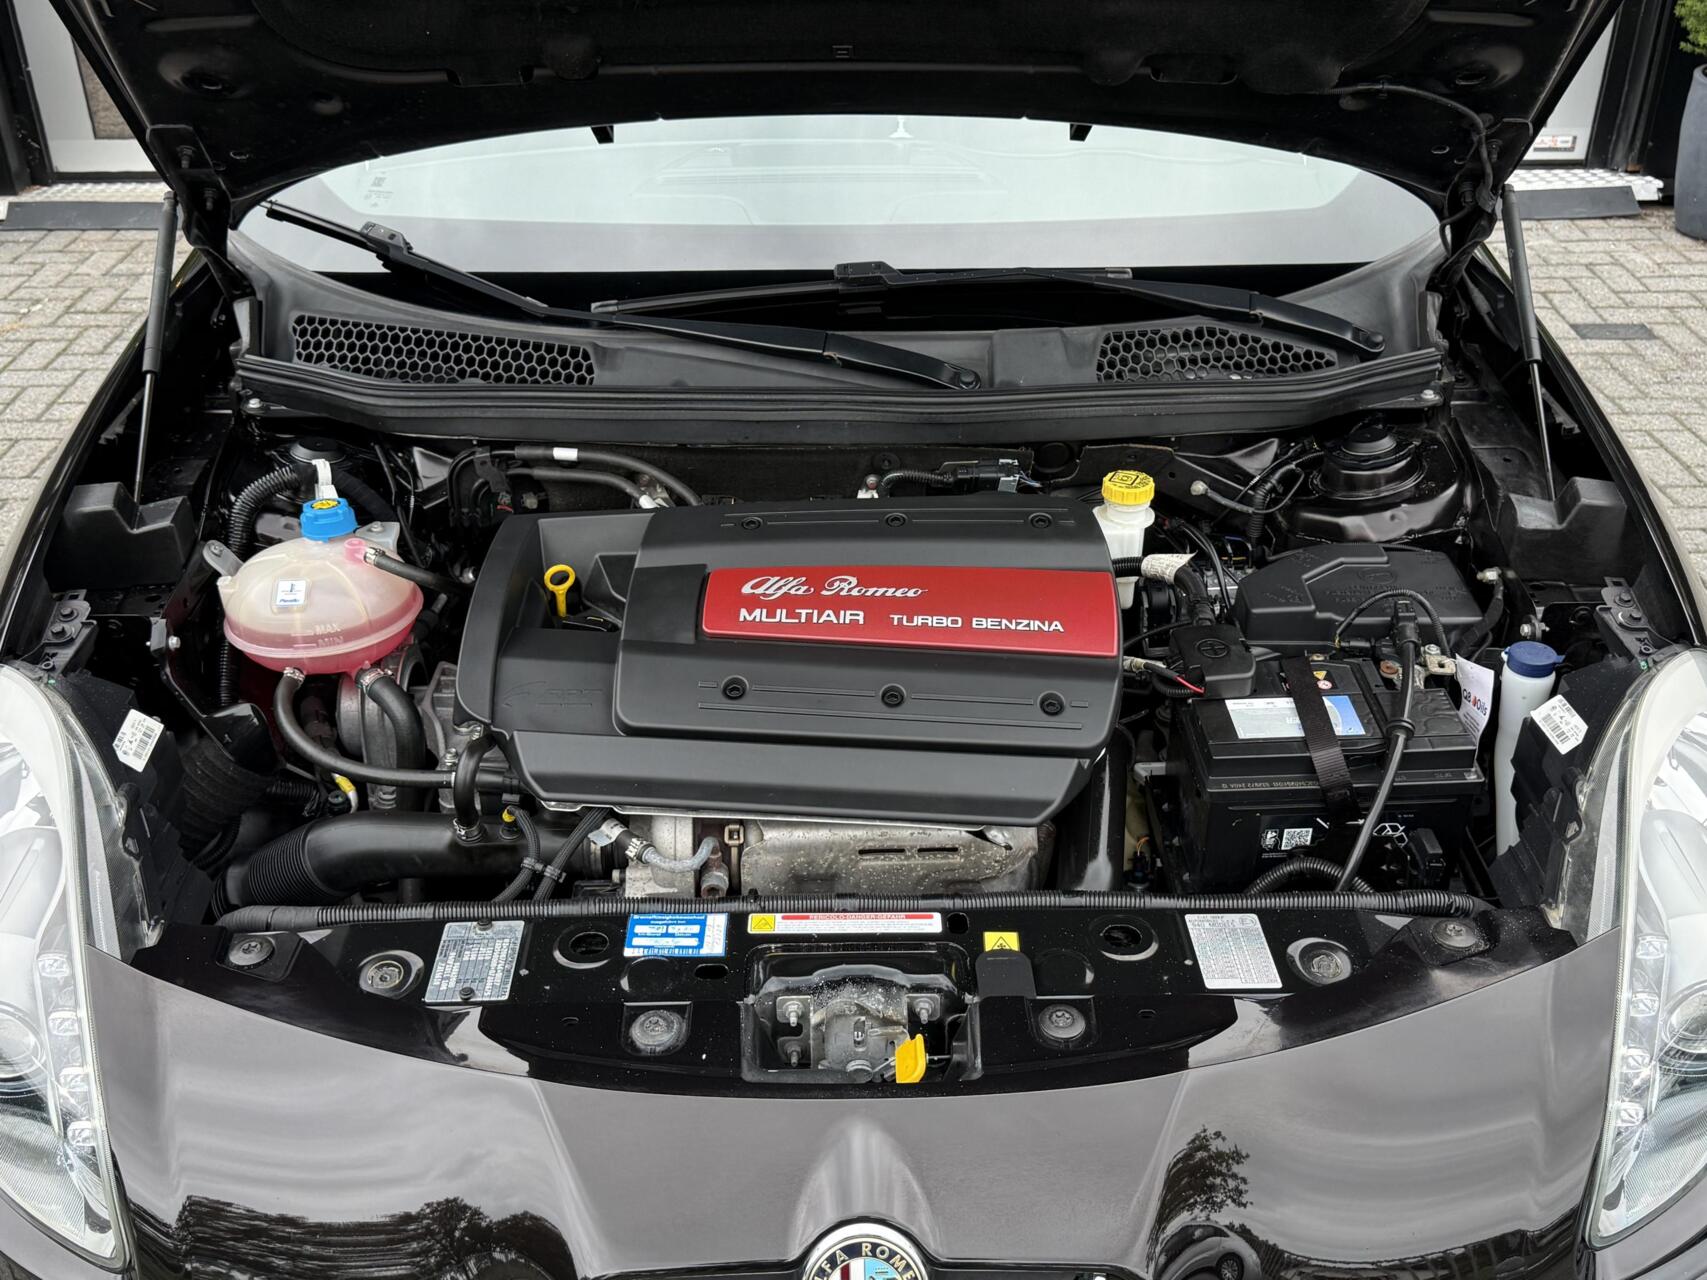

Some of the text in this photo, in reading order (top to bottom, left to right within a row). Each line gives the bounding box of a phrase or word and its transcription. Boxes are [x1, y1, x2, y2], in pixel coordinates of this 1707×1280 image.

[740, 575, 928, 601] Alfa Romeo
[739, 607, 1065, 633] MULTIAIR TURBO BENZINA
